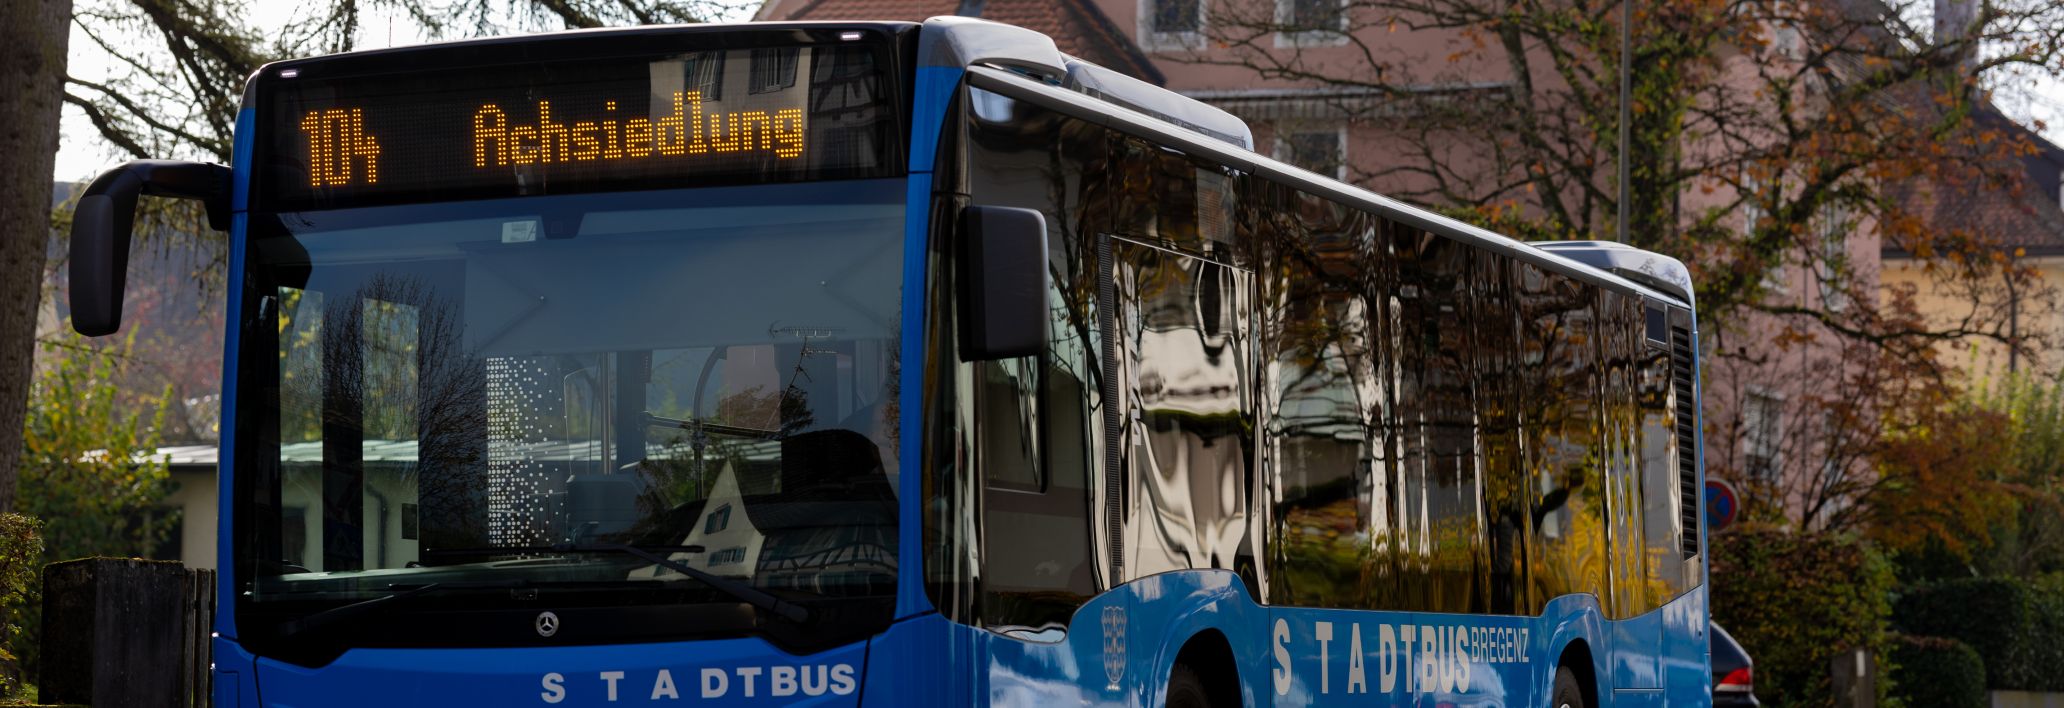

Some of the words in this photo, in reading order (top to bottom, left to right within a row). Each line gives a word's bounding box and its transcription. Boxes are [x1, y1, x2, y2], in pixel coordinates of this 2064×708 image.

[301, 107, 380, 187] 104
[474, 91, 804, 167] Achsiedlung
[1472, 626, 1530, 663] BREGENZ
